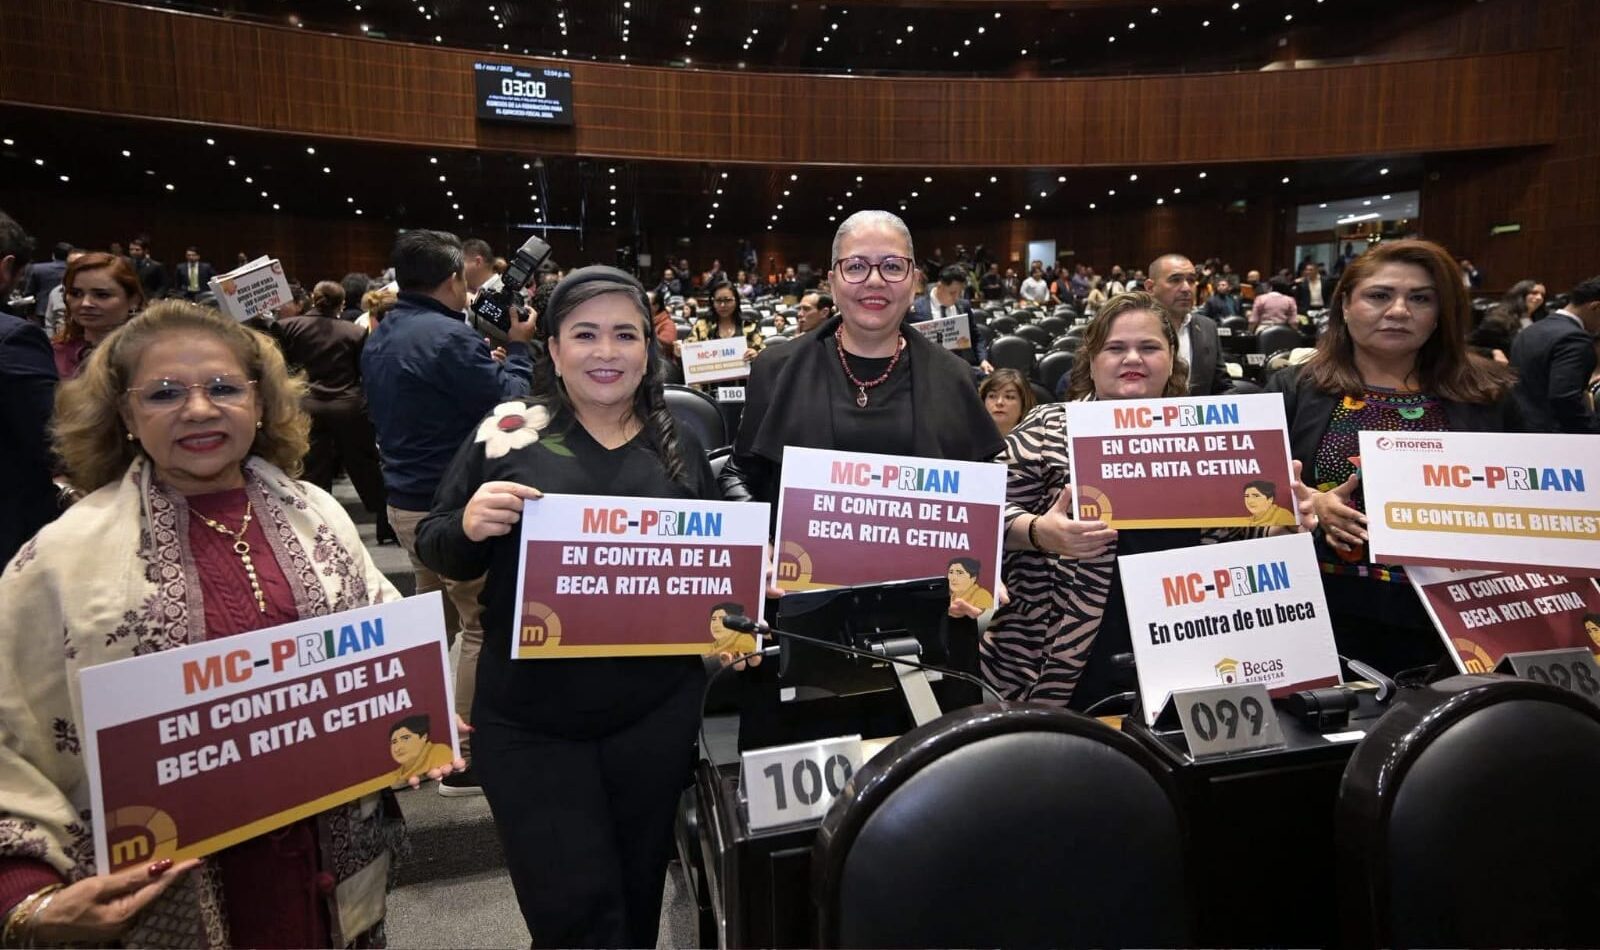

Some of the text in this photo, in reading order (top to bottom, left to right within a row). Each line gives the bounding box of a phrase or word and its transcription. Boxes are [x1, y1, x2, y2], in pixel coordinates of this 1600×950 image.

[502, 78, 546, 98] 03:00
[723, 390, 742, 398] 180
[1114, 403, 1240, 429] MC-PRIAN
[1102, 435, 1255, 455] EN CONTRA DE LA
[1396, 441, 1443, 449] morena
[830, 460, 960, 494] MC-PRIAN
[1100, 458, 1261, 479] BECA RITA CETINA
[1423, 464, 1585, 492] MC-PRIAN
[582, 508, 722, 537] MC-PRIAN
[813, 494, 968, 523] EN CONTRA DE LA
[1392, 507, 1413, 524] EN
[1417, 509, 1489, 529] CONTRA
[1493, 512, 1526, 530] DEL
[808, 520, 970, 550] BECA RITA CETINA
[562, 546, 731, 567] EN CONTRA DE LA
[556, 575, 733, 595] BECA RITA CETINA
[1162, 561, 1290, 607] MC-PRIAN
[1447, 585, 1471, 603] EN
[1470, 575, 1529, 599] CONTRA
[1525, 573, 1550, 589] DE
[1148, 601, 1316, 645] En contra de tu beca
[1459, 592, 1587, 629] BECA RITA CETINA
[182, 618, 385, 695] MC-PRIAN
[1242, 659, 1283, 676] Becas
[158, 657, 405, 745] EN CONTRA DE LA
[1191, 696, 1263, 741] 099
[156, 688, 413, 786] BECA RITA CETINA
[764, 754, 853, 810] 100
